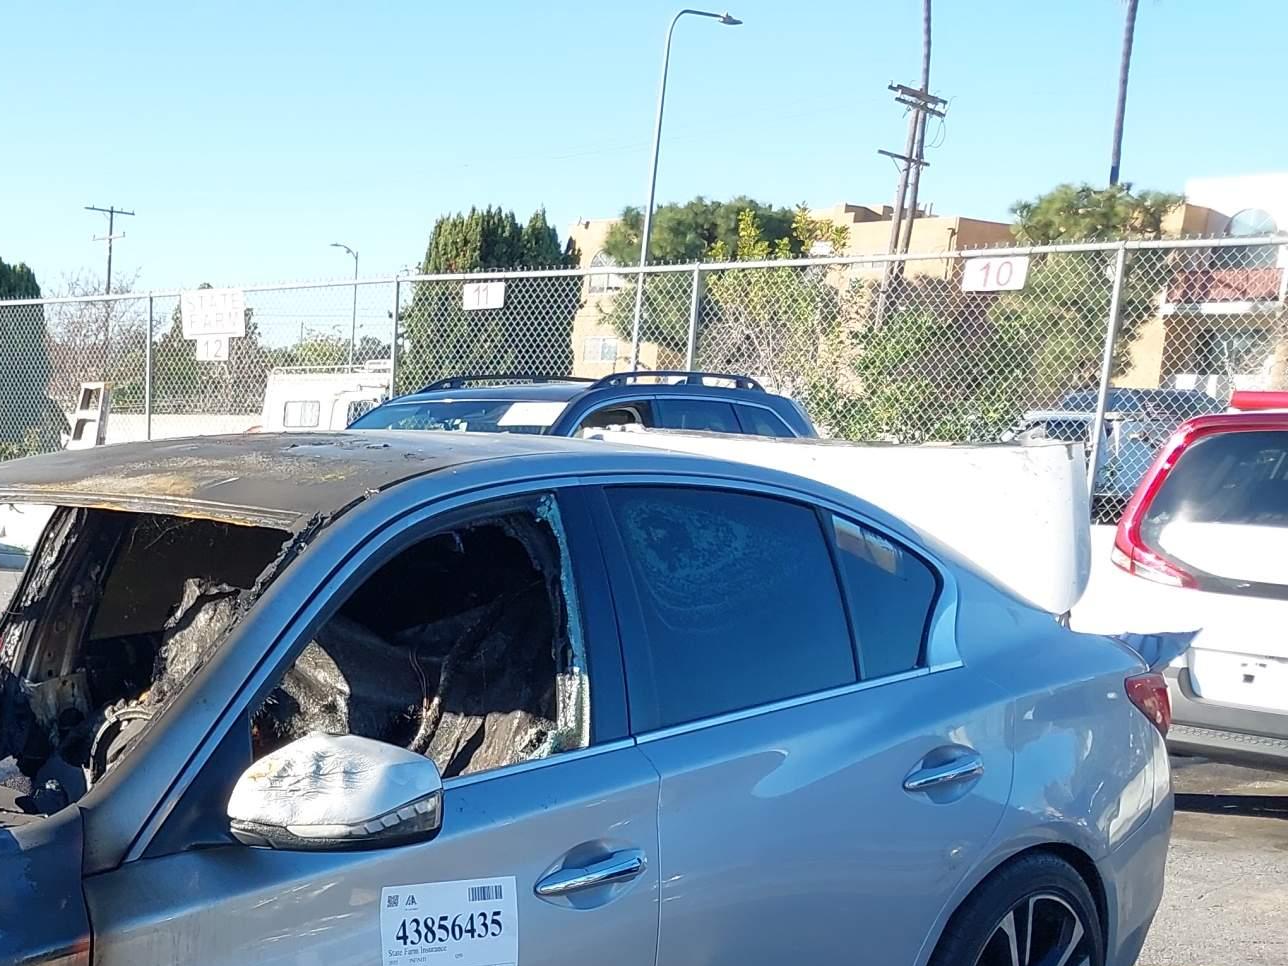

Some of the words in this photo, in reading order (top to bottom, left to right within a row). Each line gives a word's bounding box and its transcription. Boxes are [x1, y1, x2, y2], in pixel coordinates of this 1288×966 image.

[979, 260, 1013, 288] 10
[185, 293, 240, 310] STATE
[473, 284, 488, 306] 11
[190, 312, 241, 329] FARM
[203, 339, 223, 359] 12
[395, 911, 503, 946] 43856435
[388, 949, 403, 957] State
[404, 948, 419, 956] Farm
[420, 945, 447, 954] Insurance
